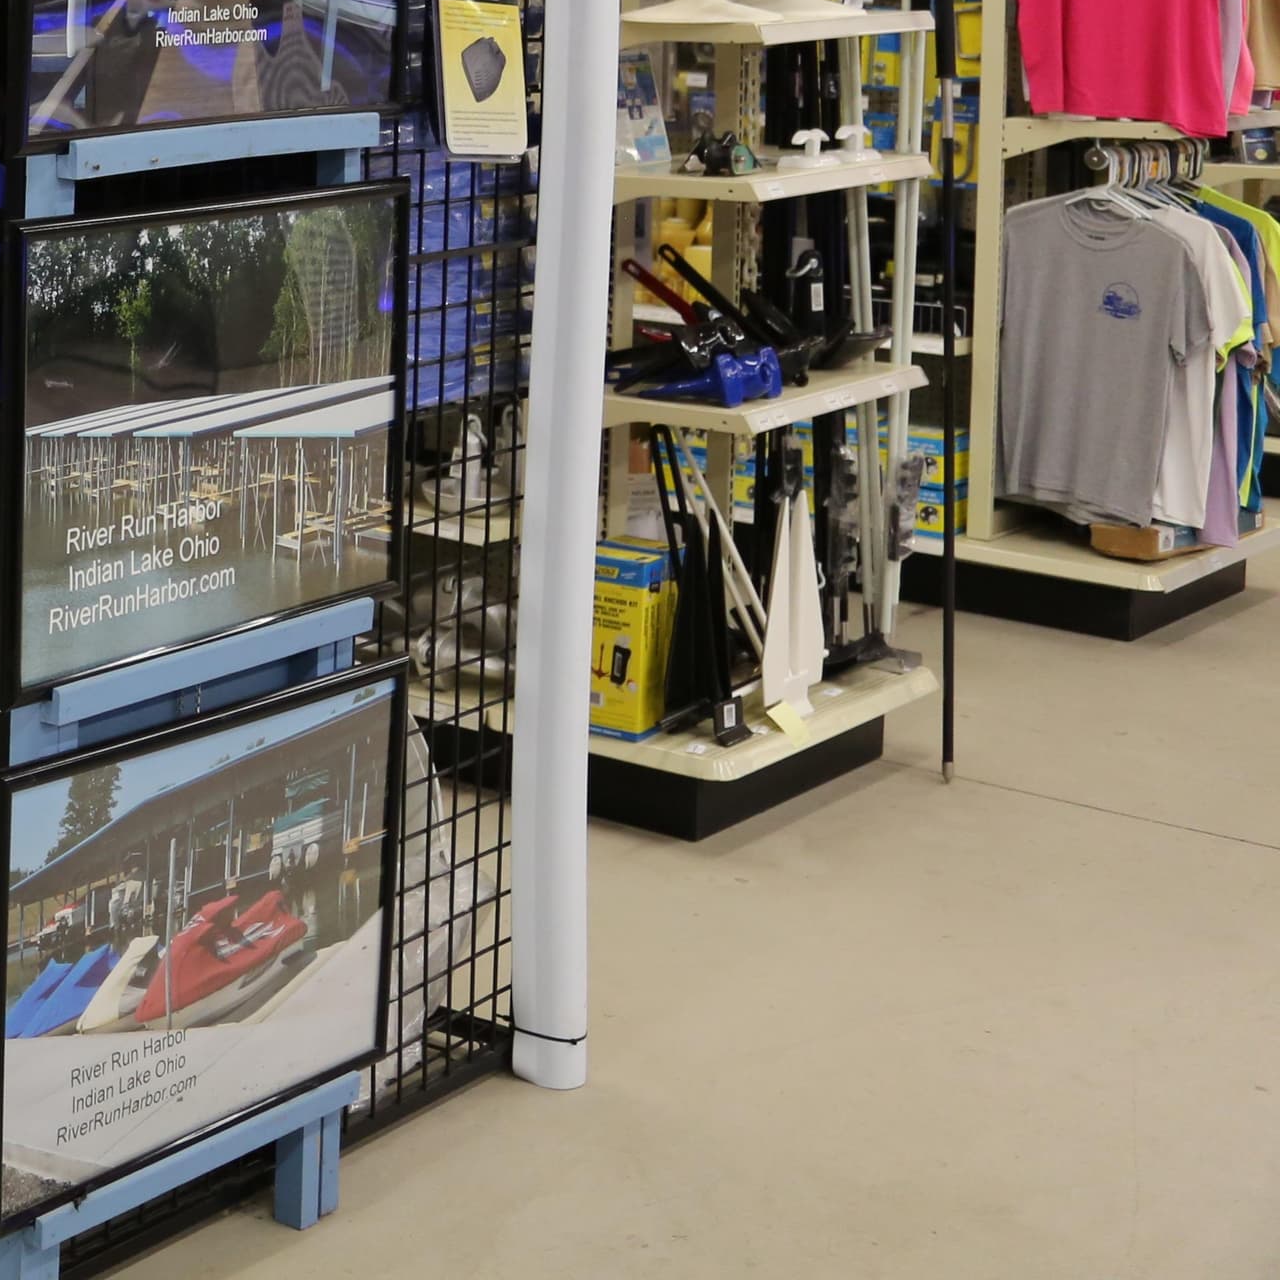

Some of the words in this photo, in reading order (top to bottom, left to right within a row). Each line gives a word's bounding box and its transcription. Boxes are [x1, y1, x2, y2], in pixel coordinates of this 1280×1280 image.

[155, 28, 268, 48] RiverRunHarbor.com
[167, 7, 200, 23] Indian
[203, 5, 230, 22] Lake
[233, 3, 259, 20] Ohio
[65, 523, 116, 555] River
[120, 512, 157, 541] Run
[162, 498, 223, 531] Harbor
[69, 559, 124, 592] Indian
[130, 545, 174, 583] Lake
[179, 532, 221, 565] Ohio
[48, 565, 236, 636] RiverRunHarbor.com
[70, 1057, 108, 1088] River
[111, 1047, 139, 1072] Run
[143, 1029, 188, 1060] Harbor
[71, 1085, 114, 1114] Indian
[118, 1069, 151, 1096] Lake
[155, 1053, 187, 1080] Ohio
[56, 1074, 198, 1146] RiverRunHarbor.com
